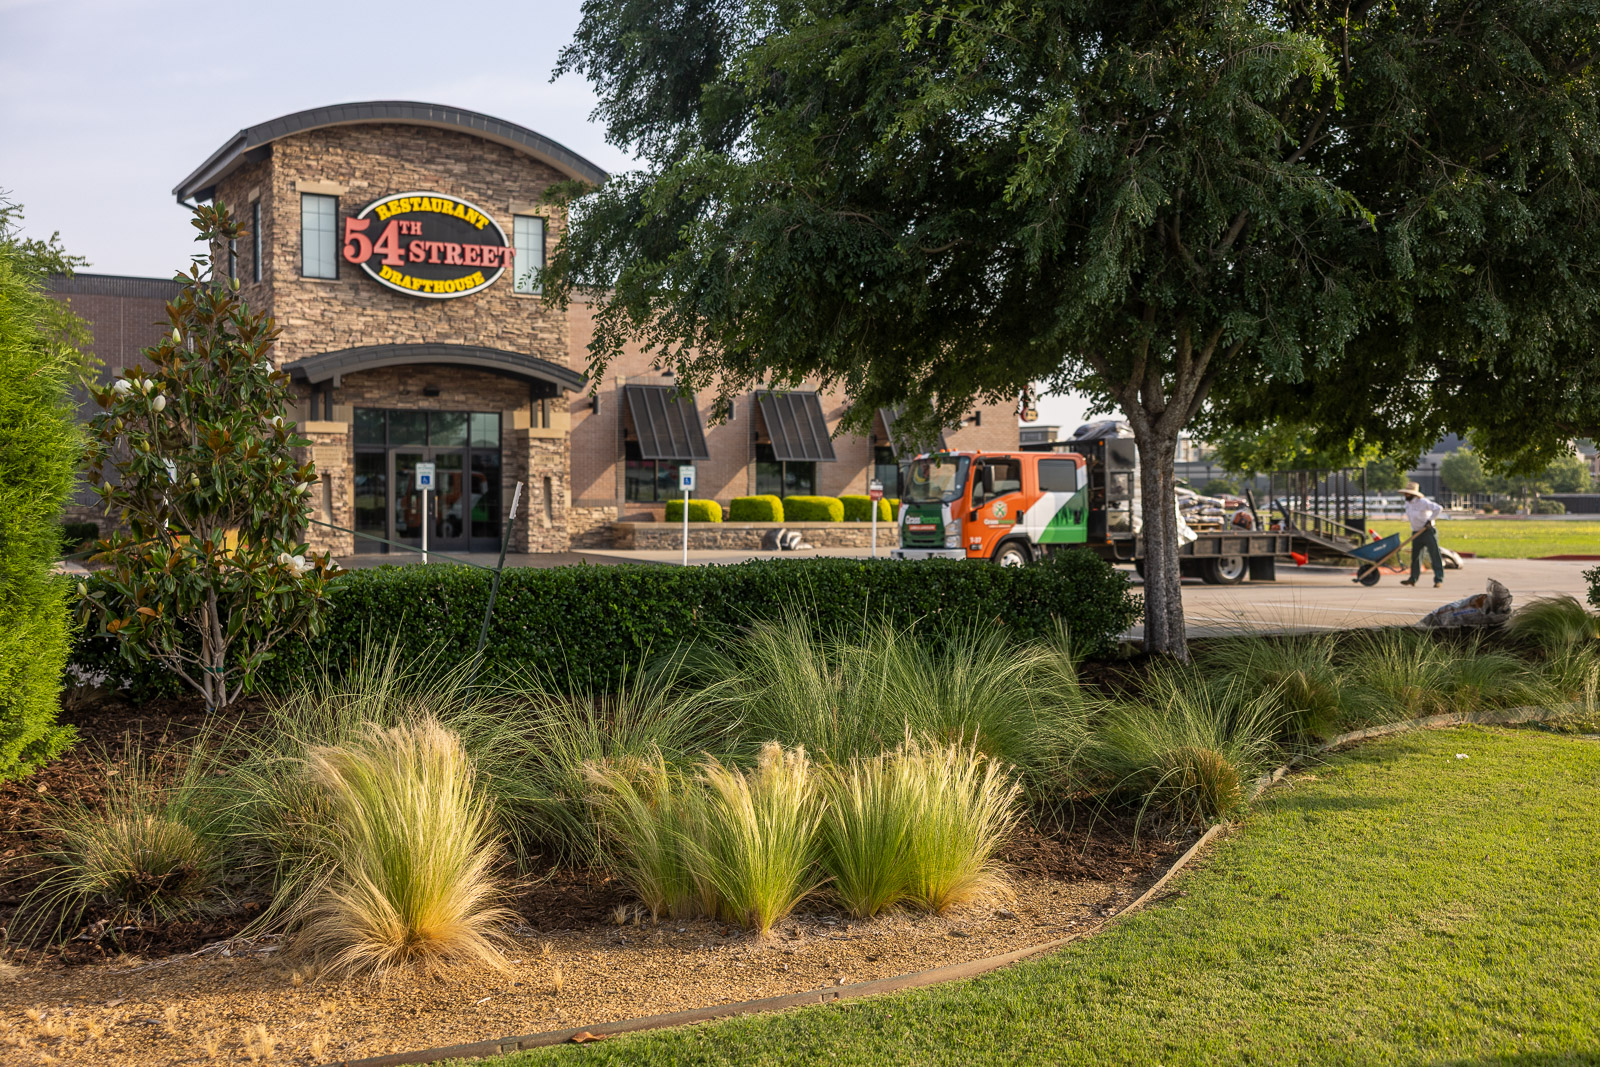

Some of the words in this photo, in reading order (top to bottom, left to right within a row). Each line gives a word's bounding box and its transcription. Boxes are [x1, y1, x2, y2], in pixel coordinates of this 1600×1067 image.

[375, 197, 489, 230] RESTAURANT
[409, 240, 516, 268] STREET
[379, 265, 486, 293] DRAFTHOUSE
